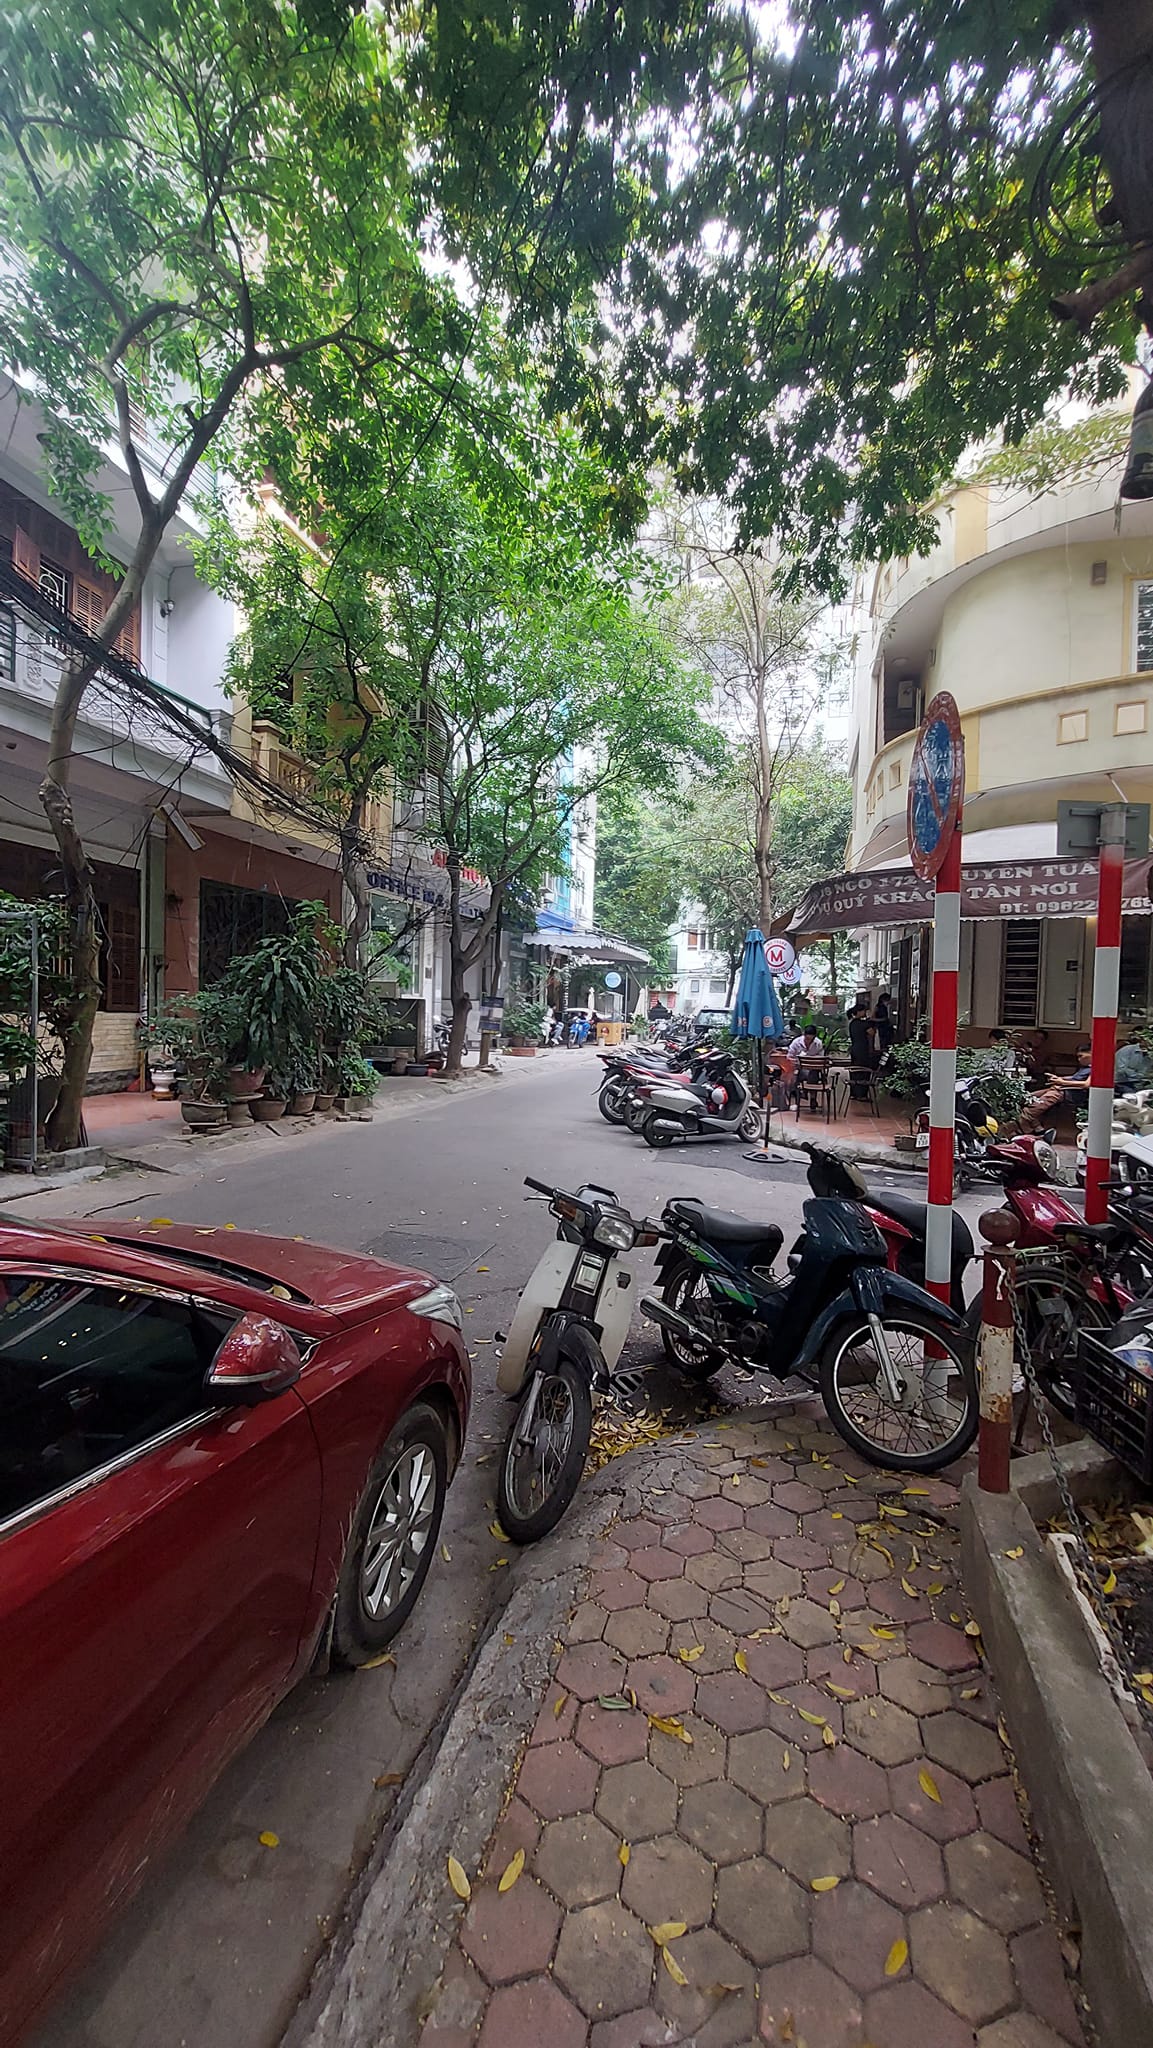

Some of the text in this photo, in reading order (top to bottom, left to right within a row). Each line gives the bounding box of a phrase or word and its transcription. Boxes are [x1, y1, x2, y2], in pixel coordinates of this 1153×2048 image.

[879, 875, 917, 888] 172
[833, 893, 867, 913] QUÝ
[1029, 881, 1079, 897] NƠI
